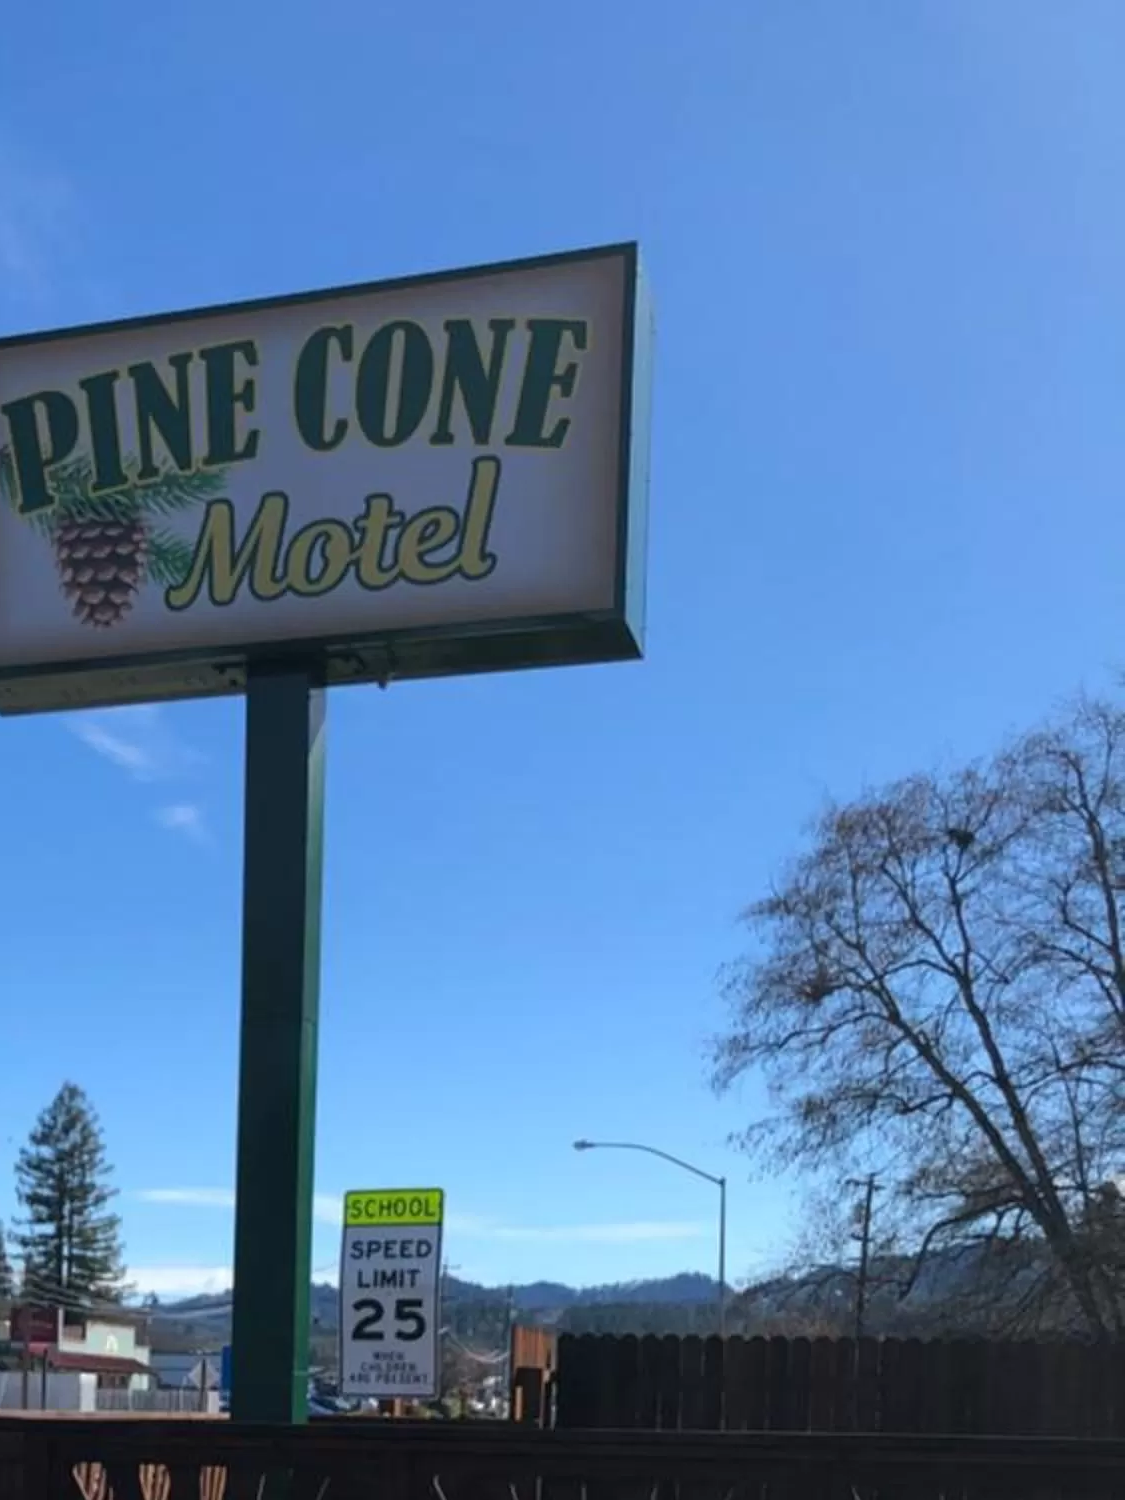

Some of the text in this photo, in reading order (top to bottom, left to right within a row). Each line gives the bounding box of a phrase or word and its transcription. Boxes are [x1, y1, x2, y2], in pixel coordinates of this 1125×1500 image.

[0, 318, 588, 515] PINE CONE
[164, 456, 501, 611] Motel
[350, 1196, 435, 1219] SCHOOL
[350, 1239, 432, 1260] SPEED
[357, 1268, 421, 1289] LIMIT
[351, 1298, 427, 1341] 25
